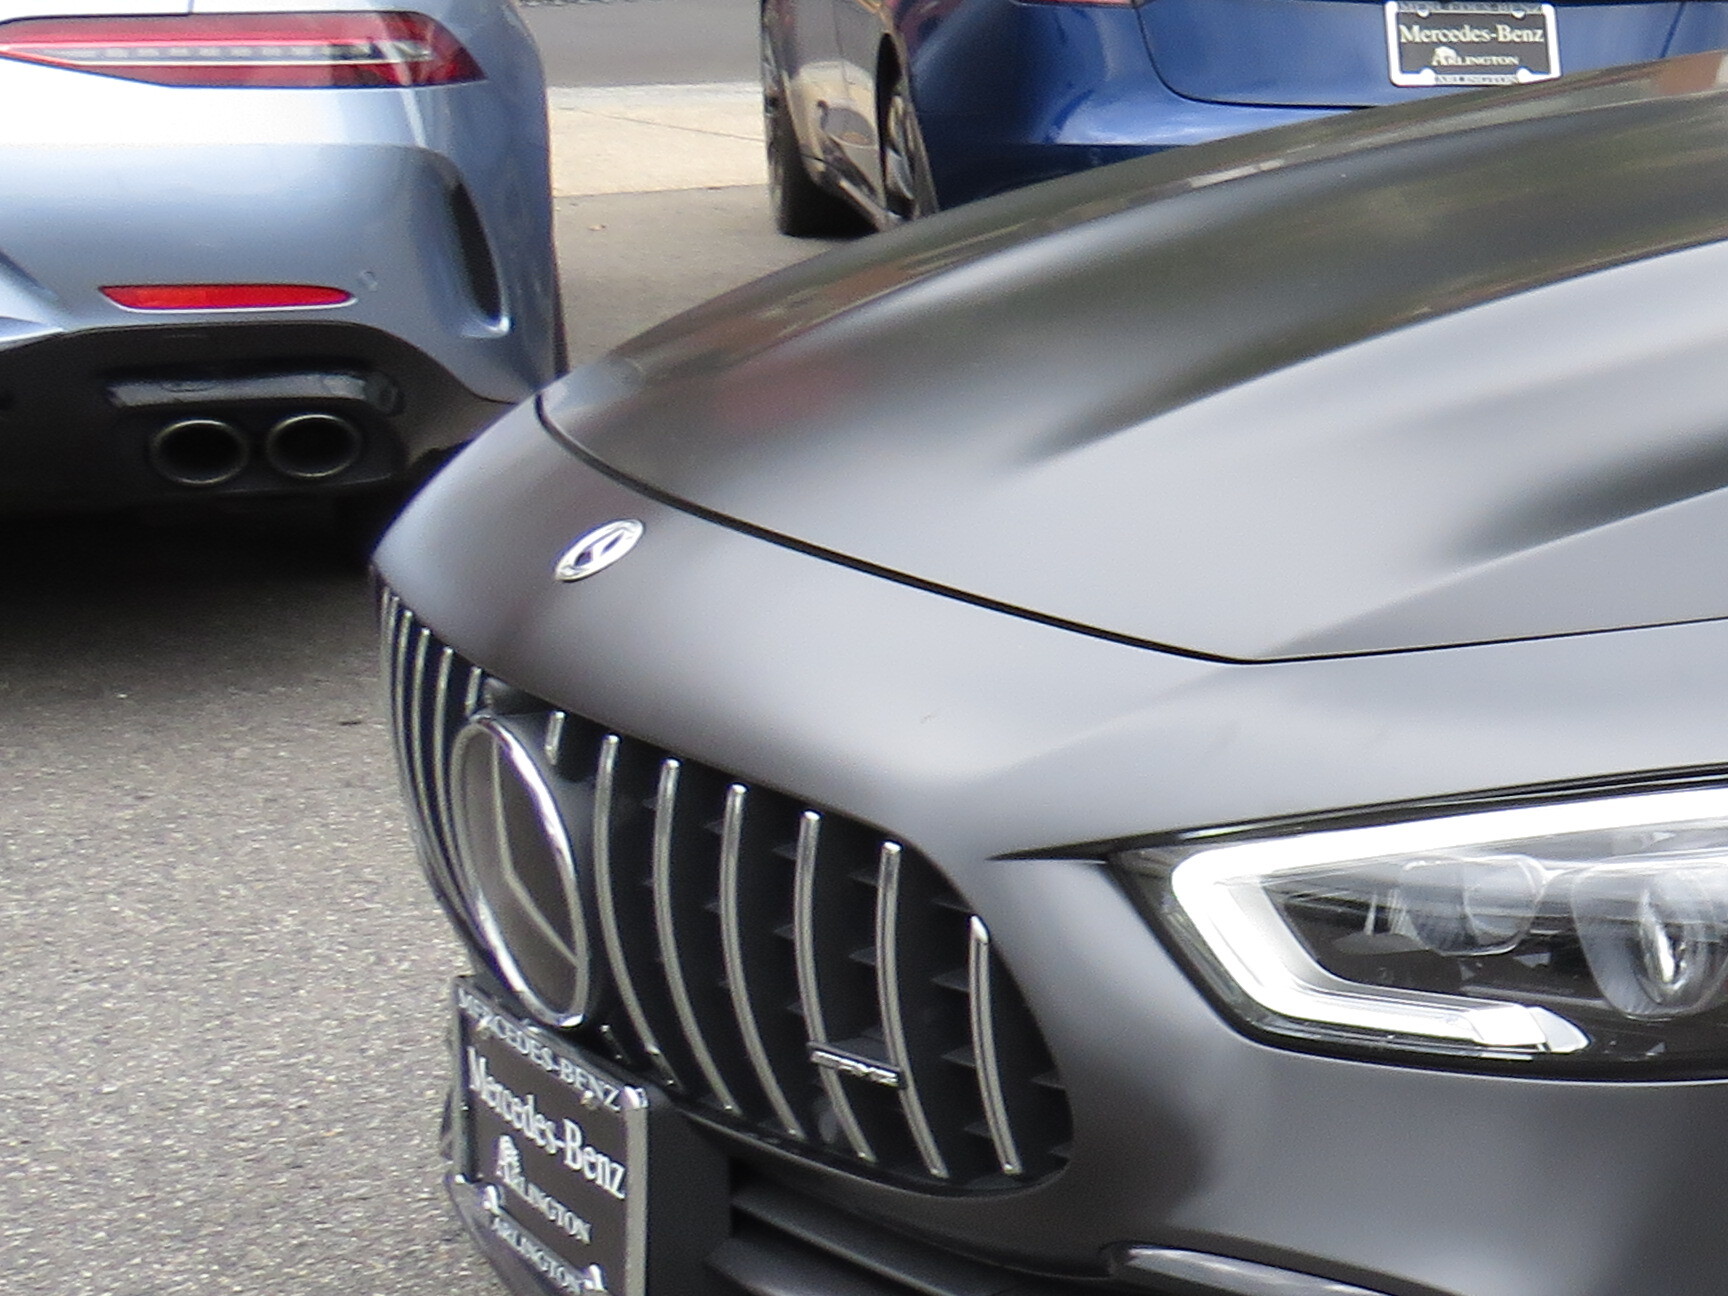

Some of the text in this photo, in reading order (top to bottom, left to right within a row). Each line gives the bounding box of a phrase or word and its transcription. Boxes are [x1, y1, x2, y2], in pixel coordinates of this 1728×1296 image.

[1398, 24, 1545, 43] Mercedes-Benz
[458, 988, 622, 1112] MERCEDES-BENZ
[467, 1046, 627, 1201] Mercedes-Benz
